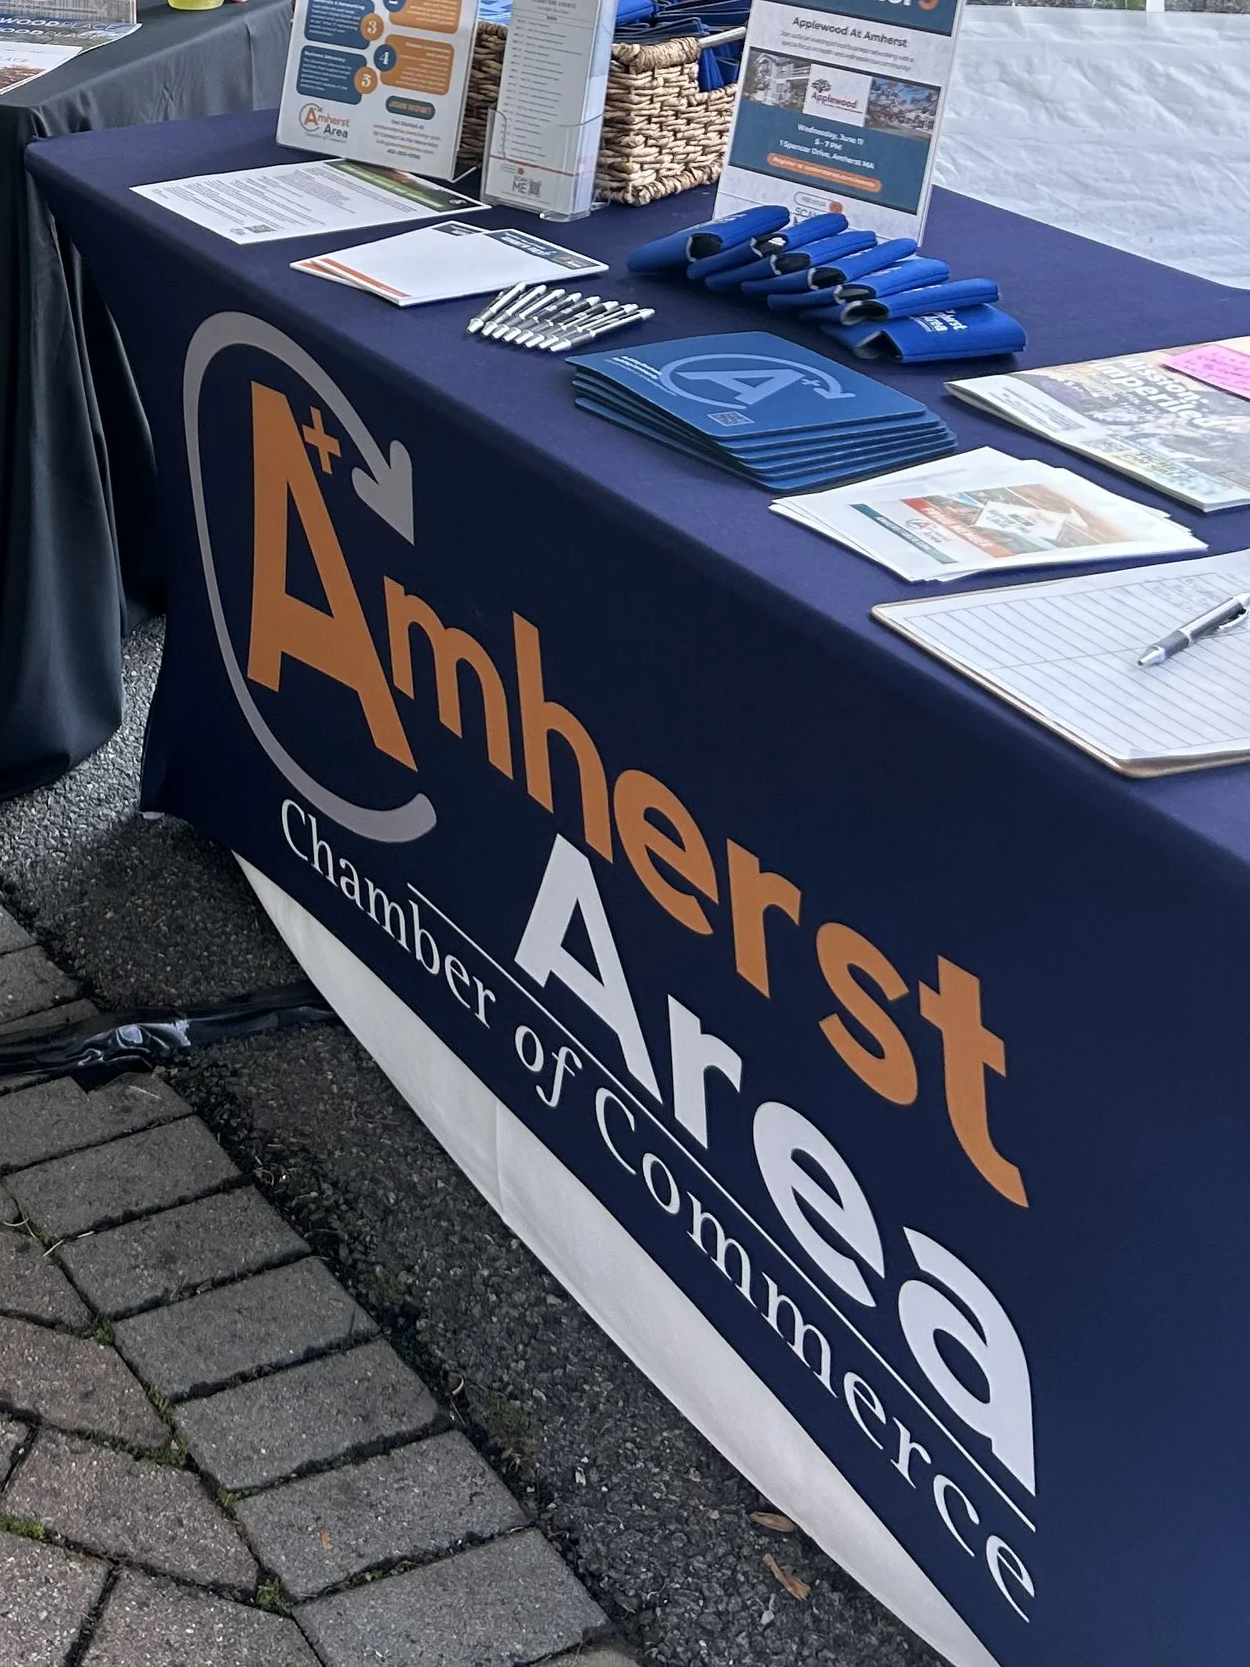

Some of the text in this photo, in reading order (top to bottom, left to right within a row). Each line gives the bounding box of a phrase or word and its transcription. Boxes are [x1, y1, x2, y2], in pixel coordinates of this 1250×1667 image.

[367, 20, 377, 34] 3
[792, 17, 907, 48] Applewood At Amherst
[379, 51, 389, 65] 4
[361, 74, 371, 87] 5
[811, 92, 857, 109] Applewood
[304, 107, 350, 127] Amherst
[323, 124, 348, 138] Area
[246, 378, 1029, 1210] Amherst
[512, 831, 1037, 1498] Area
[280, 796, 1037, 1624] Chamber of Commerce
